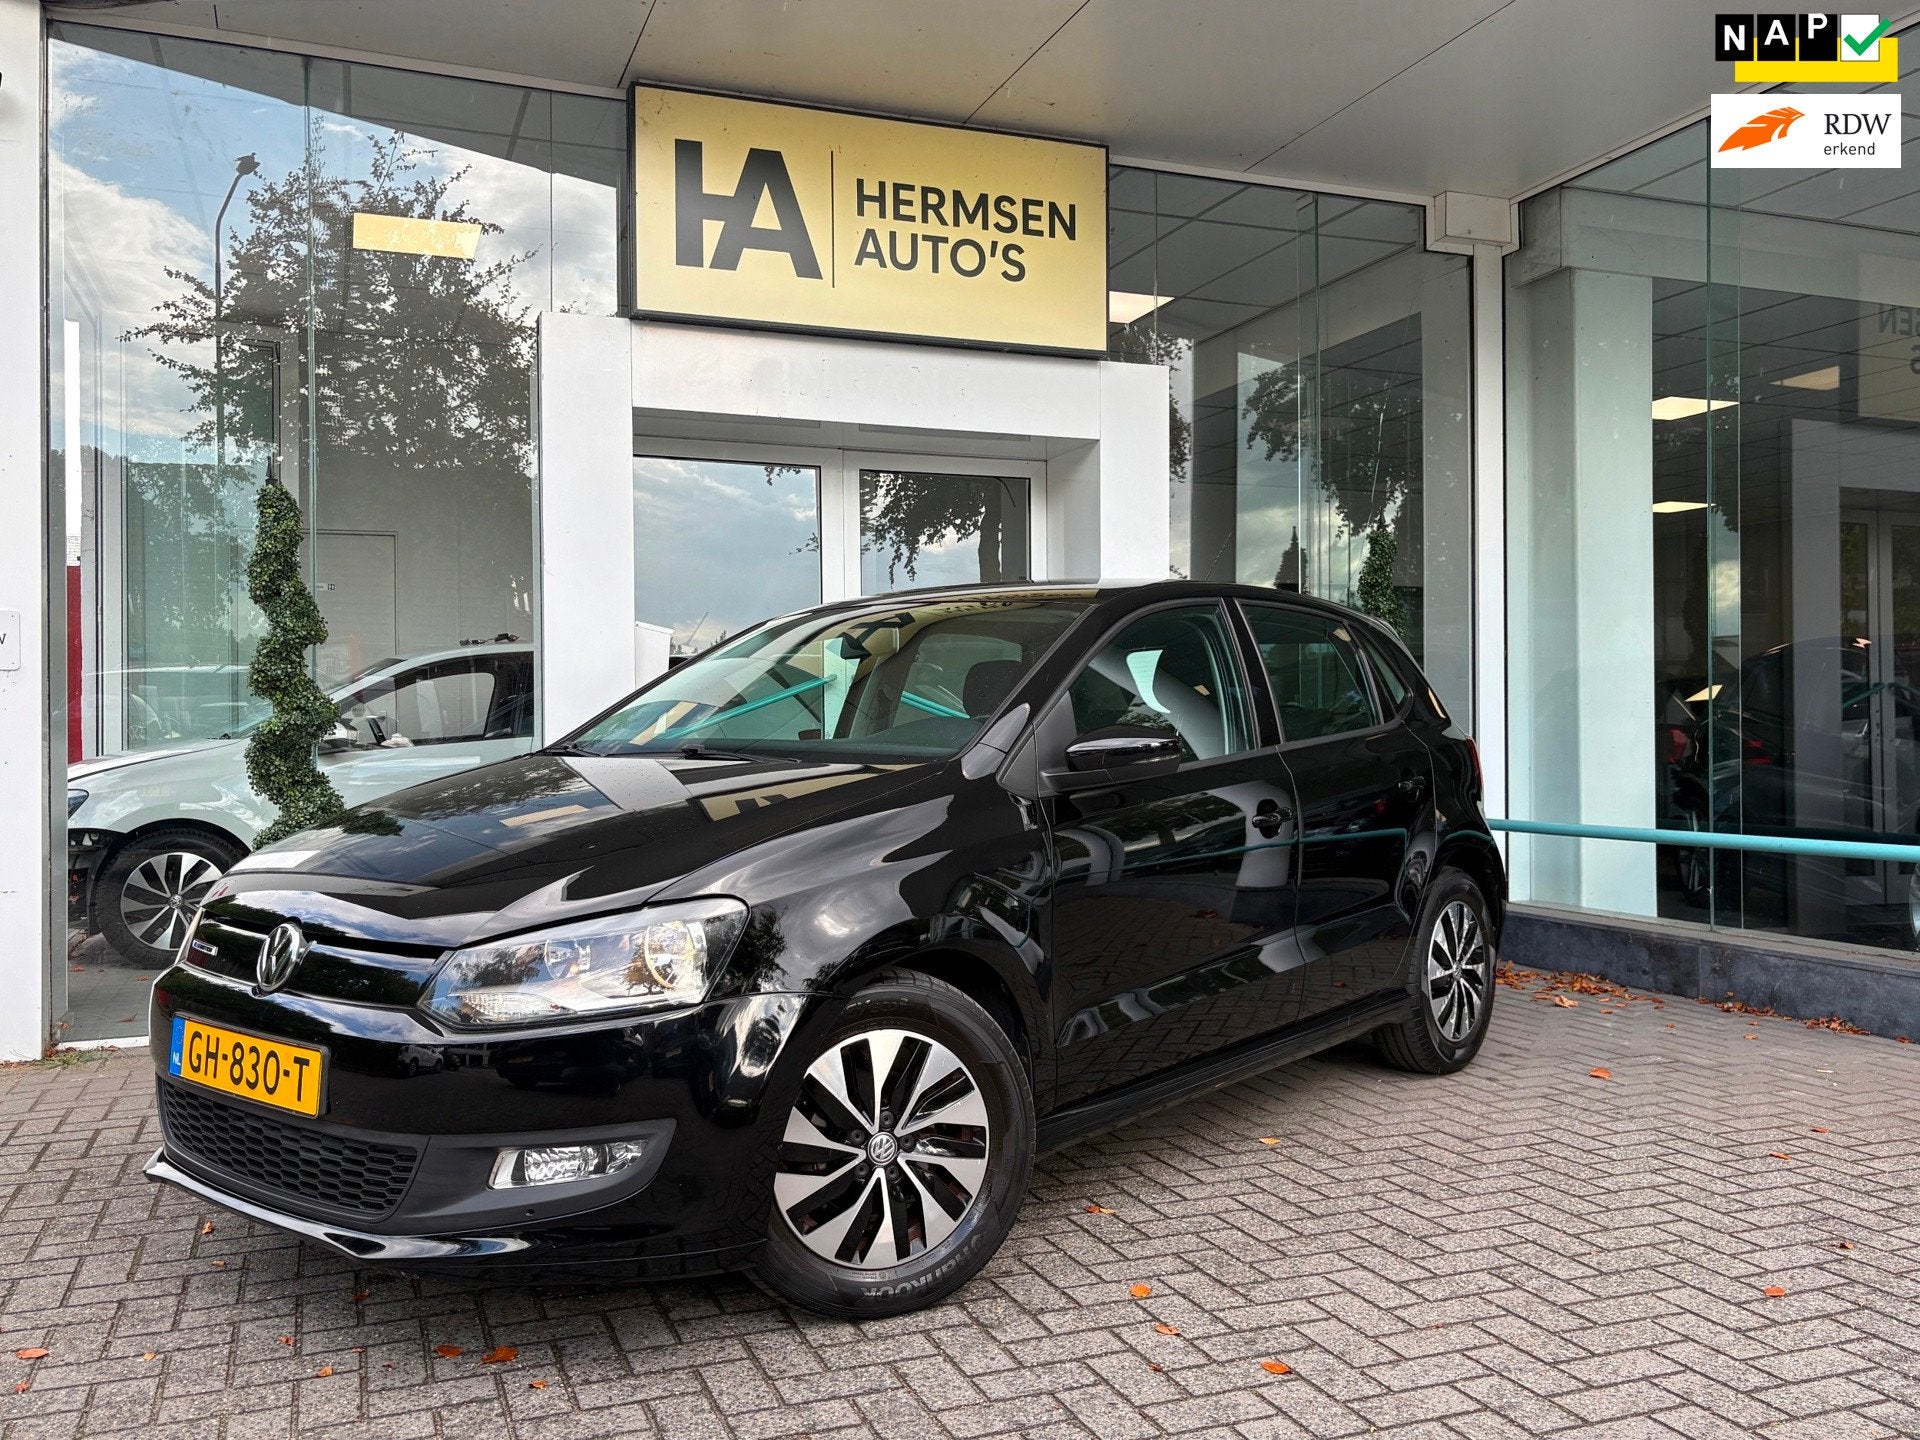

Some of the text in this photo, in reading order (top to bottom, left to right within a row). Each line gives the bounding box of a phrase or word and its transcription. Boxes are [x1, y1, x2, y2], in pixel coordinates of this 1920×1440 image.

[674, 138, 824, 280] HA
[856, 178, 1077, 241] HERMSEN
[854, 228, 1027, 283] AUTO'S
[189, 1030, 310, 1103] GH-830-T
